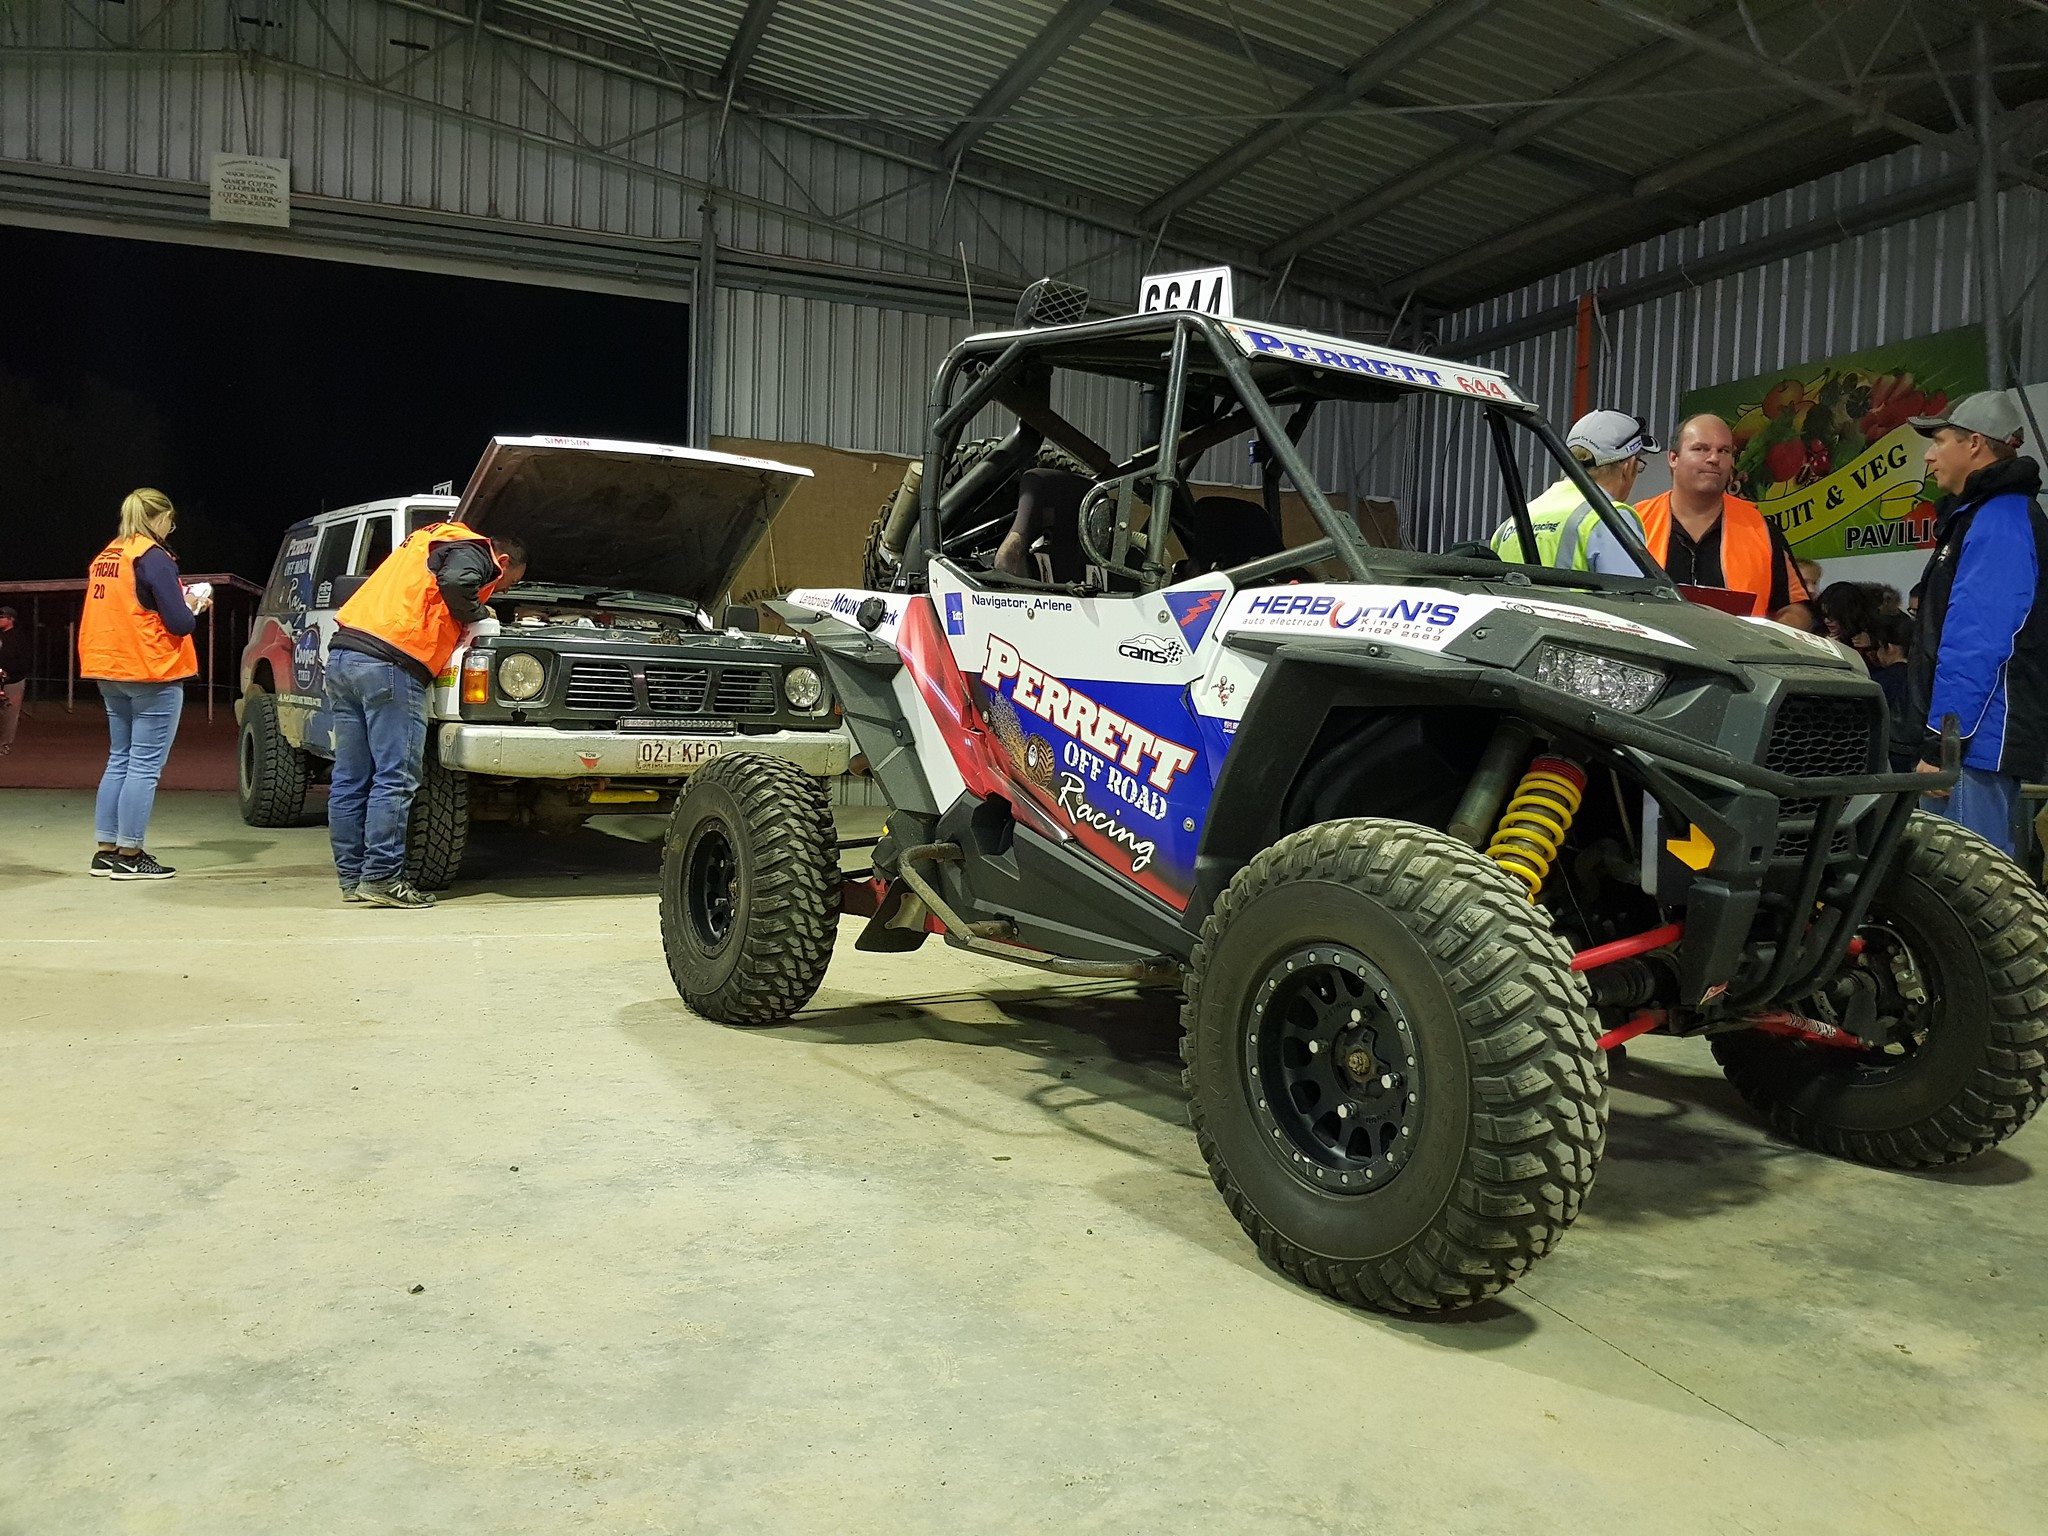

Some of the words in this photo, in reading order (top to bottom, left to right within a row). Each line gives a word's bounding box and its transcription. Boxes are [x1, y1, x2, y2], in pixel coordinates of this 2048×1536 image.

[218, 191, 248, 200] COTTON
[250, 194, 282, 204] TRADING
[224, 198, 276, 209] CORPORATION
[1243, 329, 1441, 387] PERRETT
[1455, 373, 1507, 400] 644
[545, 437, 590, 447] SIMPSON
[1825, 485, 1845, 511] &
[1850, 444, 1908, 491] VEG
[1845, 517, 1938, 550] PAVILI
[93, 584, 105, 600] 20
[972, 594, 1028, 609] Navigator:
[1033, 598, 1072, 612] Arlene
[882, 609, 899, 626] ark
[1242, 618, 1266, 626] auto
[1270, 618, 1325, 627] electrical
[1361, 618, 1446, 635] Kingaroy
[1357, 627, 1392, 635] 4162
[1401, 631, 1442, 641] 2669
[294, 644, 317, 670] Cooper
[980, 633, 1197, 793] PERRETT
[1063, 740, 1104, 782] OFF
[1106, 765, 1168, 821] ROAD
[1058, 771, 1155, 872] Racing
